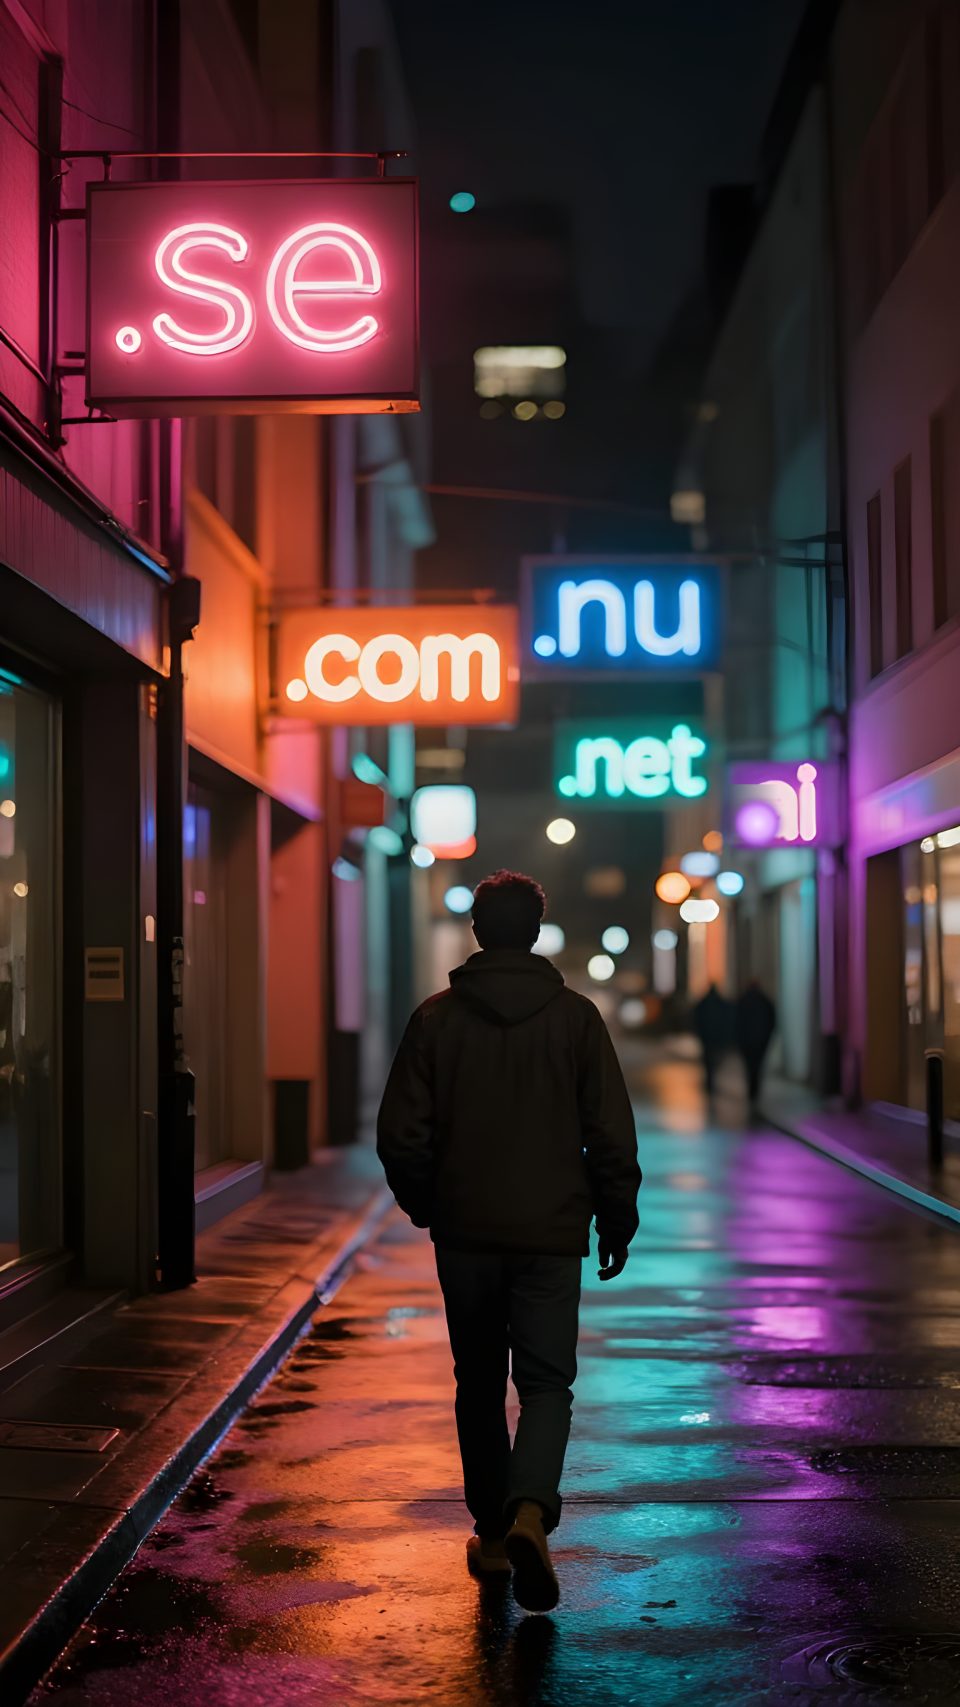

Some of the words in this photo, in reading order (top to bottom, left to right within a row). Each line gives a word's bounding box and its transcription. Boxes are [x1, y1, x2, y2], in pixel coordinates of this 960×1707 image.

[115, 222, 382, 355] .se
[534, 579, 700, 657] .nu
[286, 633, 500, 702] .com
[558, 724, 707, 798] .net
